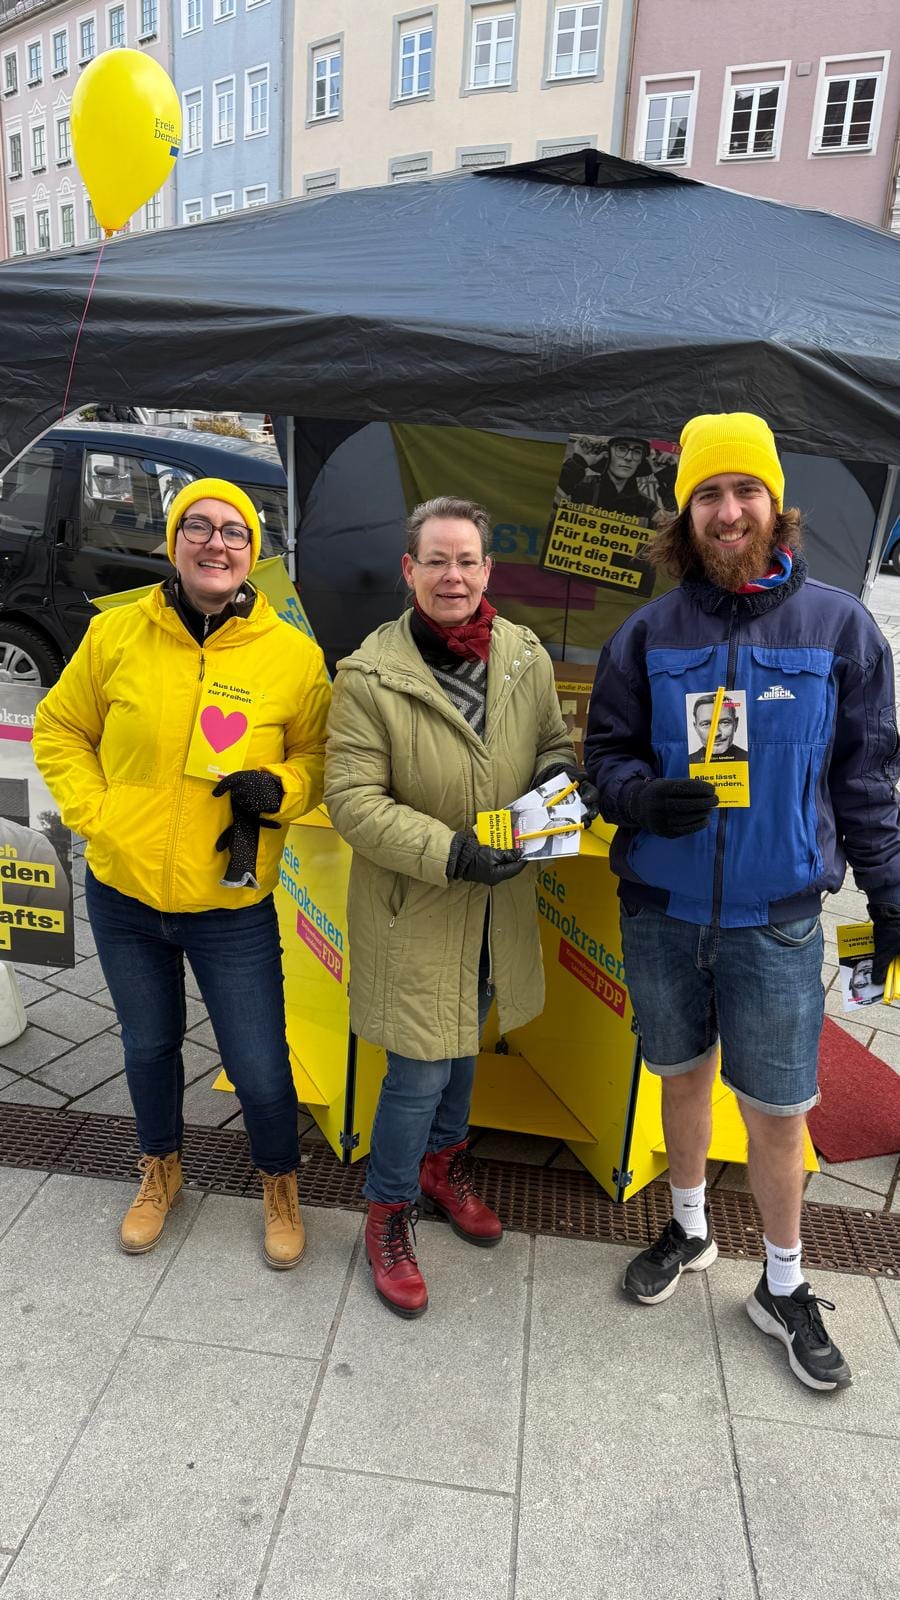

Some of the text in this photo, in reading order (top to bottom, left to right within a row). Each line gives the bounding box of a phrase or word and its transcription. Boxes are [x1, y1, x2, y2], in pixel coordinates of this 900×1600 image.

[155, 117, 175, 132] Freie
[558, 511, 597, 529] Alles
[560, 498, 640, 525] Paul Friedrich
[551, 540, 608, 562] Und die
[554, 525, 580, 540] Für
[582, 532, 633, 553] Leben.
[548, 554, 637, 585] Wirtschaft.
[213, 681, 250, 695] Aus Liebe
[222, 691, 252, 704] Freiheit
[283, 844, 300, 875] eie
[536, 869, 566, 904] reie
[278, 864, 344, 953] emokraten
[322, 943, 342, 975] FDP
[595, 973, 624, 1008] FDP
